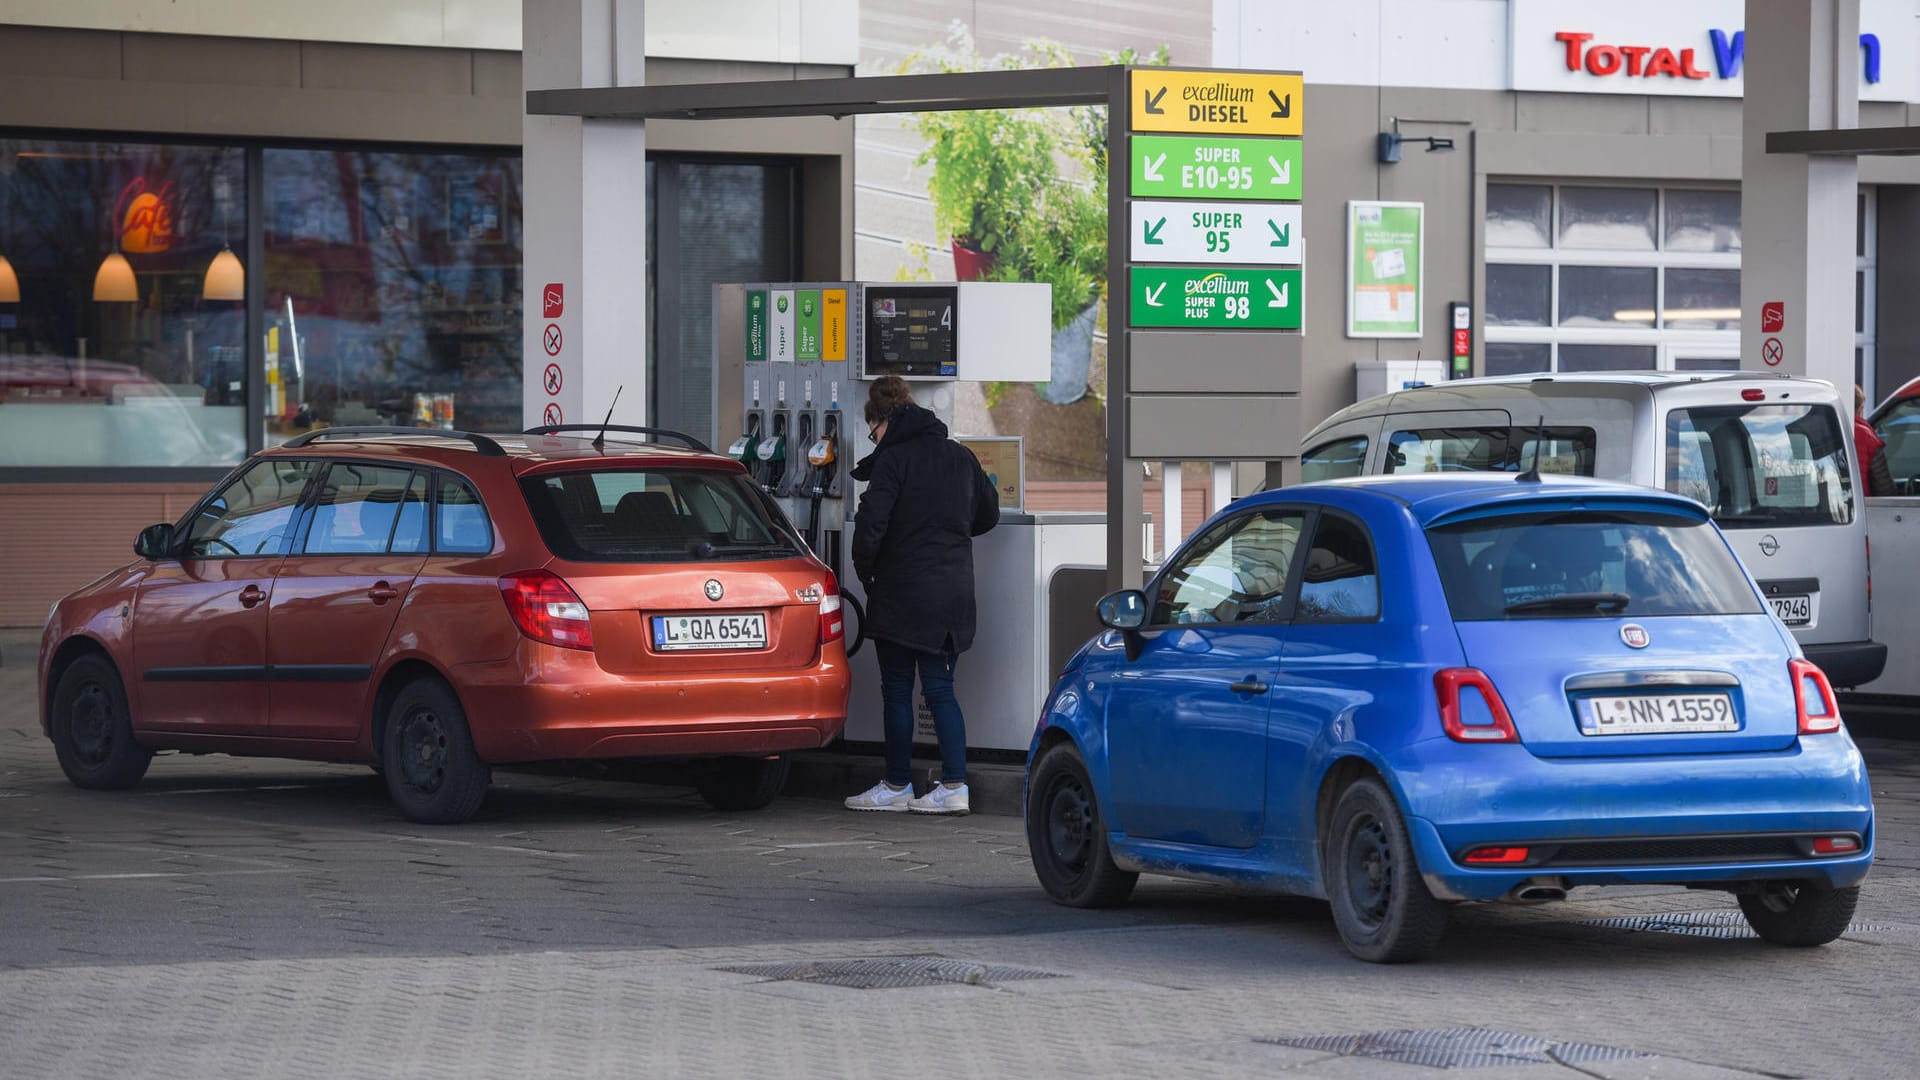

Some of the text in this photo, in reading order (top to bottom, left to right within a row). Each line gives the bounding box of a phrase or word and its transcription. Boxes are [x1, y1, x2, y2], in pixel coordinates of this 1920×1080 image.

[1182, 83, 1254, 103] excellium
[1189, 104, 1248, 123] DIESEL
[1195, 147, 1240, 163] SUPER
[1182, 165, 1253, 190] E10-95
[1192, 212, 1242, 229] SUPER
[1206, 230, 1230, 253] 95
[1185, 276, 1249, 295] excellium
[1185, 297, 1216, 308] SUPER
[1225, 296, 1250, 319] 98
[941, 305, 951, 331] 4
[1185, 308, 1209, 319] PLUS
[1769, 599, 1807, 618] 7946
[666, 618, 763, 641] L QA 6541
[1595, 698, 1729, 724] L NN 1559
